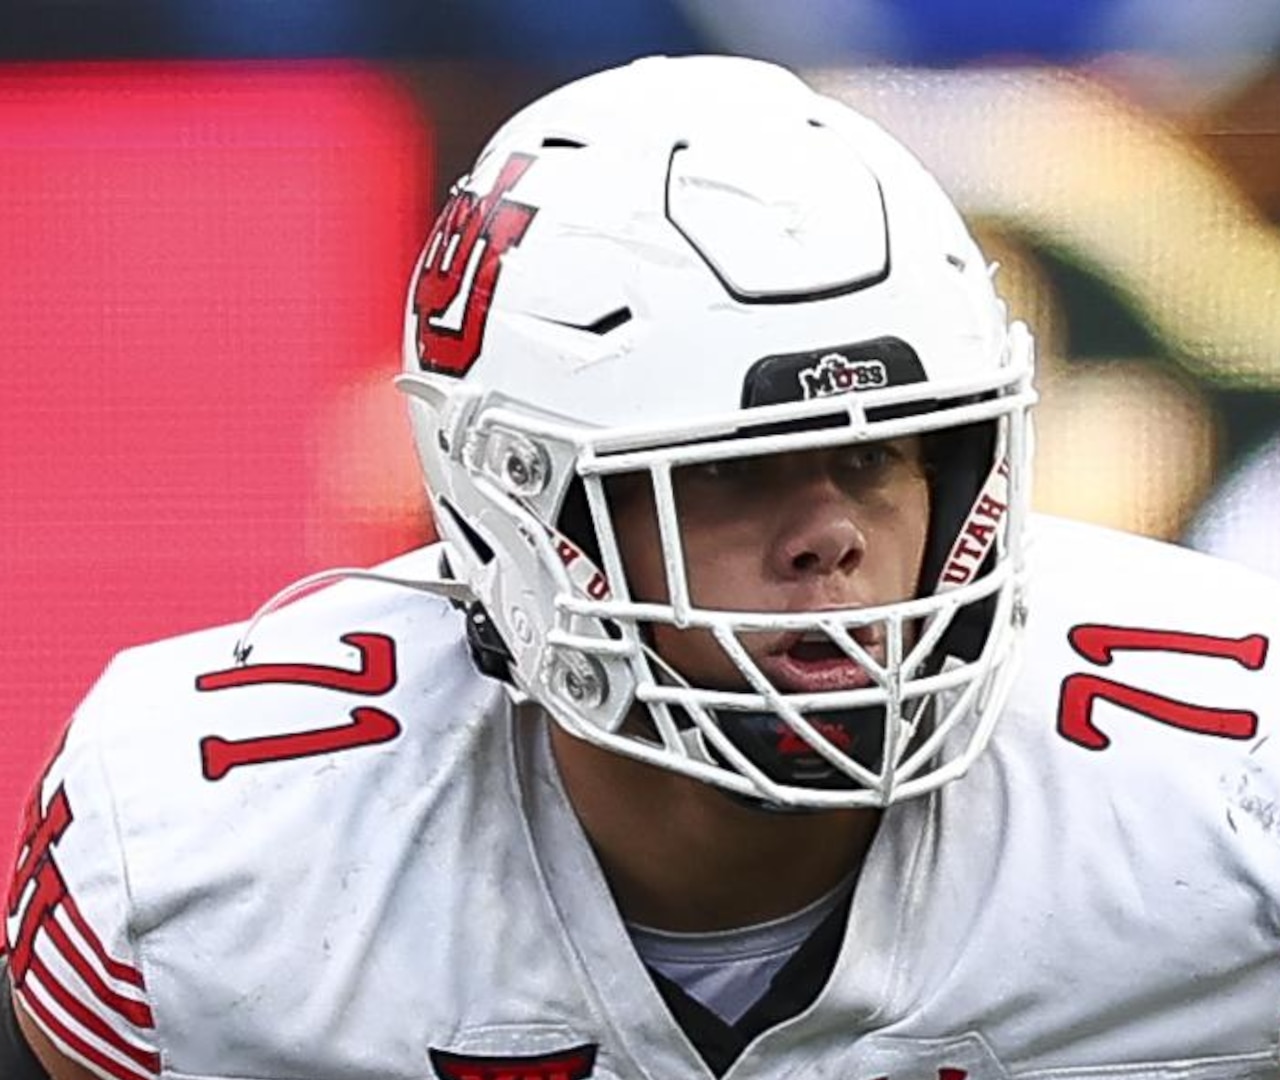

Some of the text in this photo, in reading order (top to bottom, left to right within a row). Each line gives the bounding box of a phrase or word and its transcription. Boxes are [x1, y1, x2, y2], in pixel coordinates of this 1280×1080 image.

[941, 493, 1009, 585] UTAH
[195, 632, 402, 781] 71
[1056, 623, 1269, 752] 71
